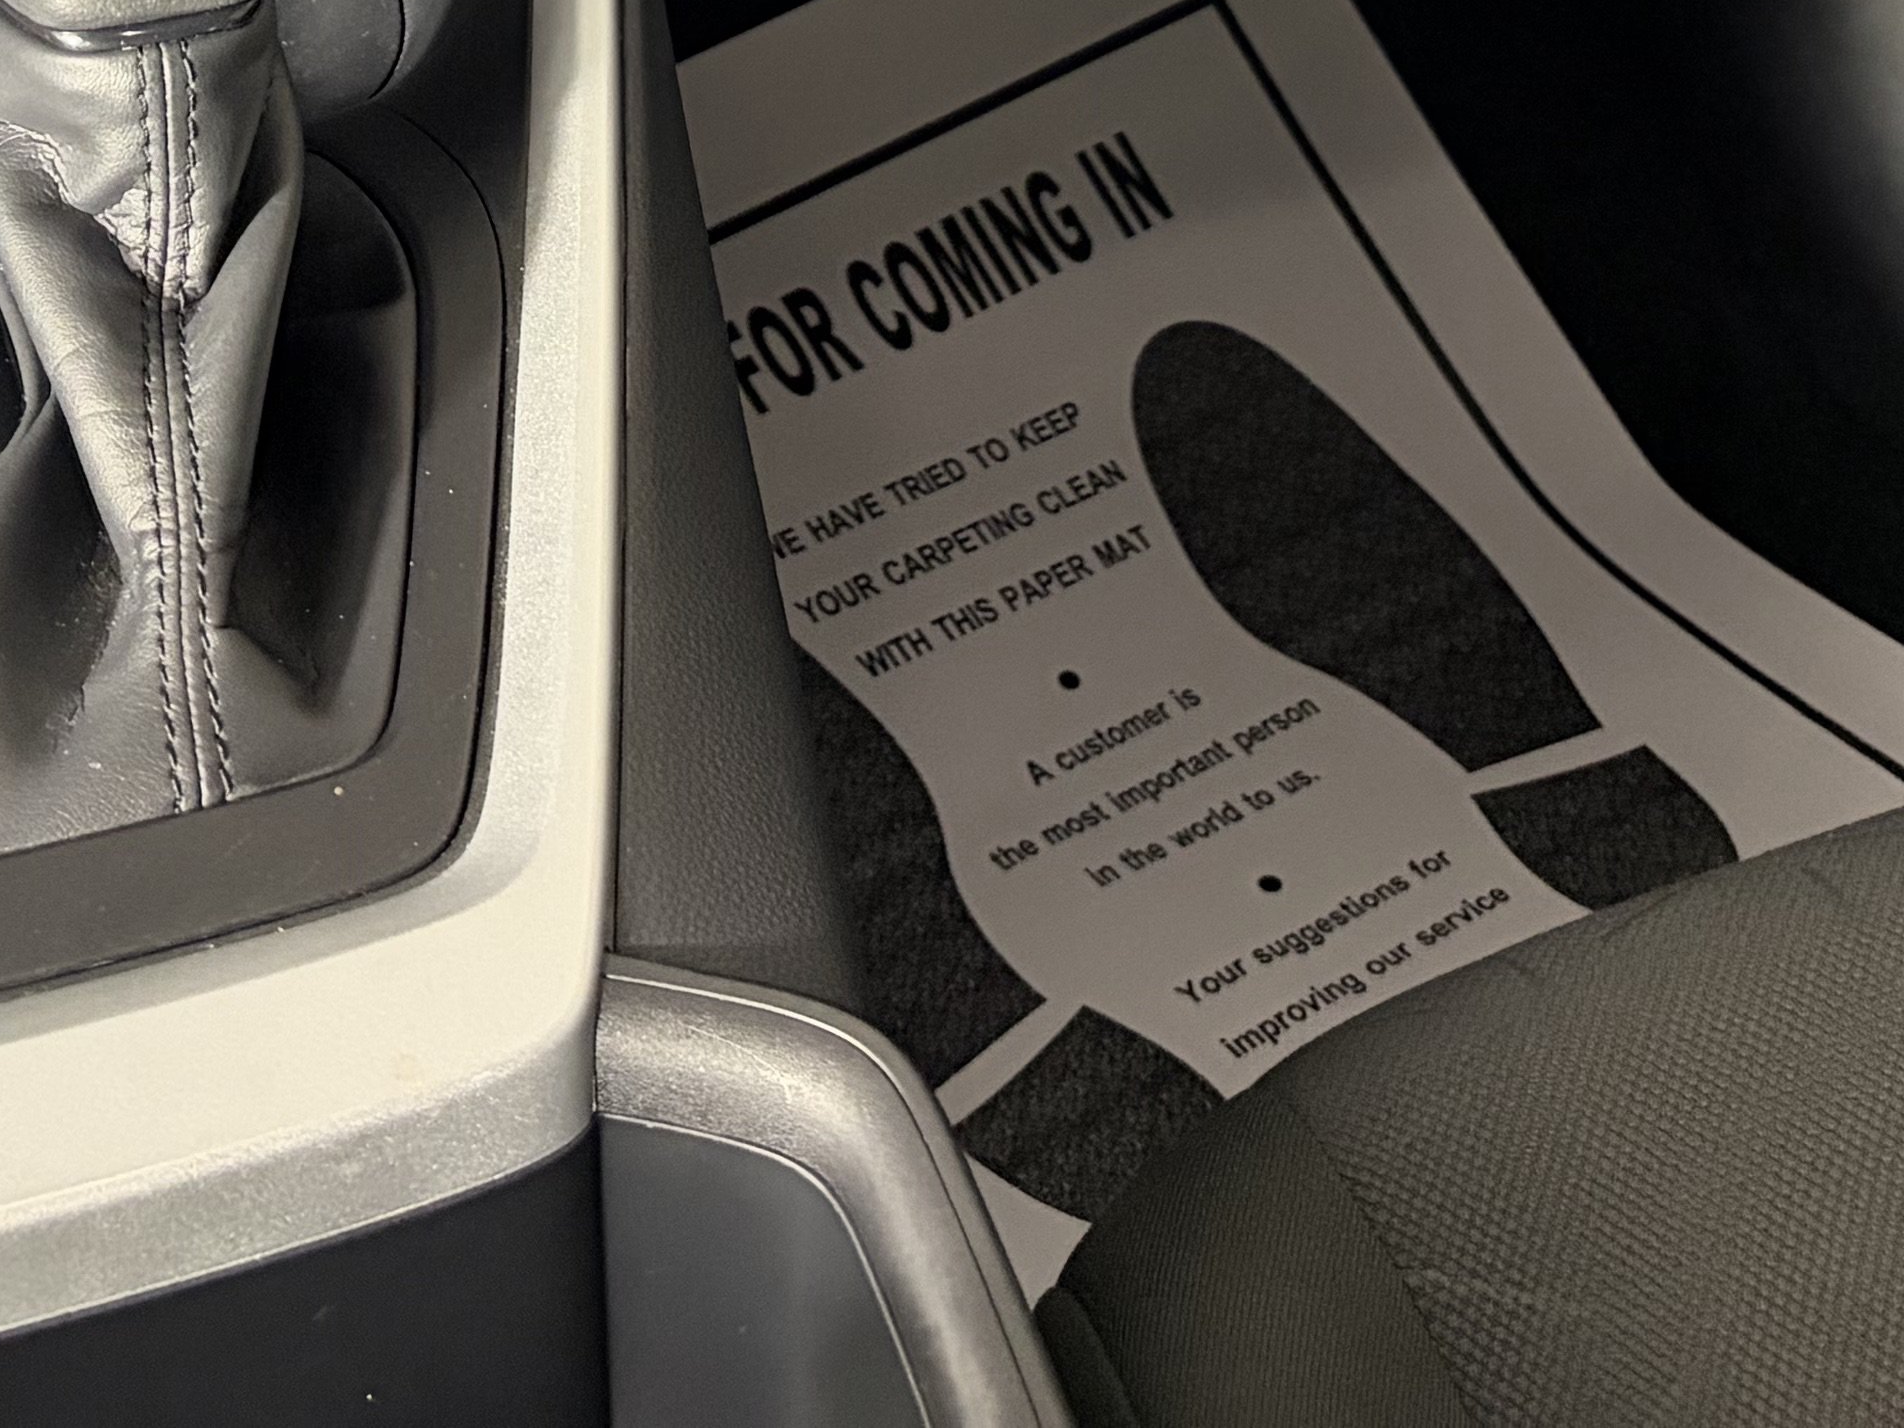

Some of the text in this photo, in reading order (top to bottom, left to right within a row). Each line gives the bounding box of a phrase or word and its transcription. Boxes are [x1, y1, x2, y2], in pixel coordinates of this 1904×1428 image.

[727, 131, 1175, 415] FOR COMING IN
[793, 459, 1129, 624] YOUR CARPETING CLEAN
[805, 492, 887, 544] HAVE
[883, 457, 967, 508] TRIED
[966, 437, 1011, 470] TO
[1009, 401, 1081, 452] KEEP
[854, 524, 1153, 678] WITH THIS PAPER MAT
[989, 697, 1322, 871] the most important person
[1026, 687, 1202, 786] A customer is
[1118, 841, 1168, 872] the
[1168, 800, 1244, 848] world
[1241, 789, 1275, 811] to
[1277, 768, 1321, 795] us.
[1174, 849, 1452, 1004] Your suggestions for
[1219, 886, 1511, 1059] improving our service
